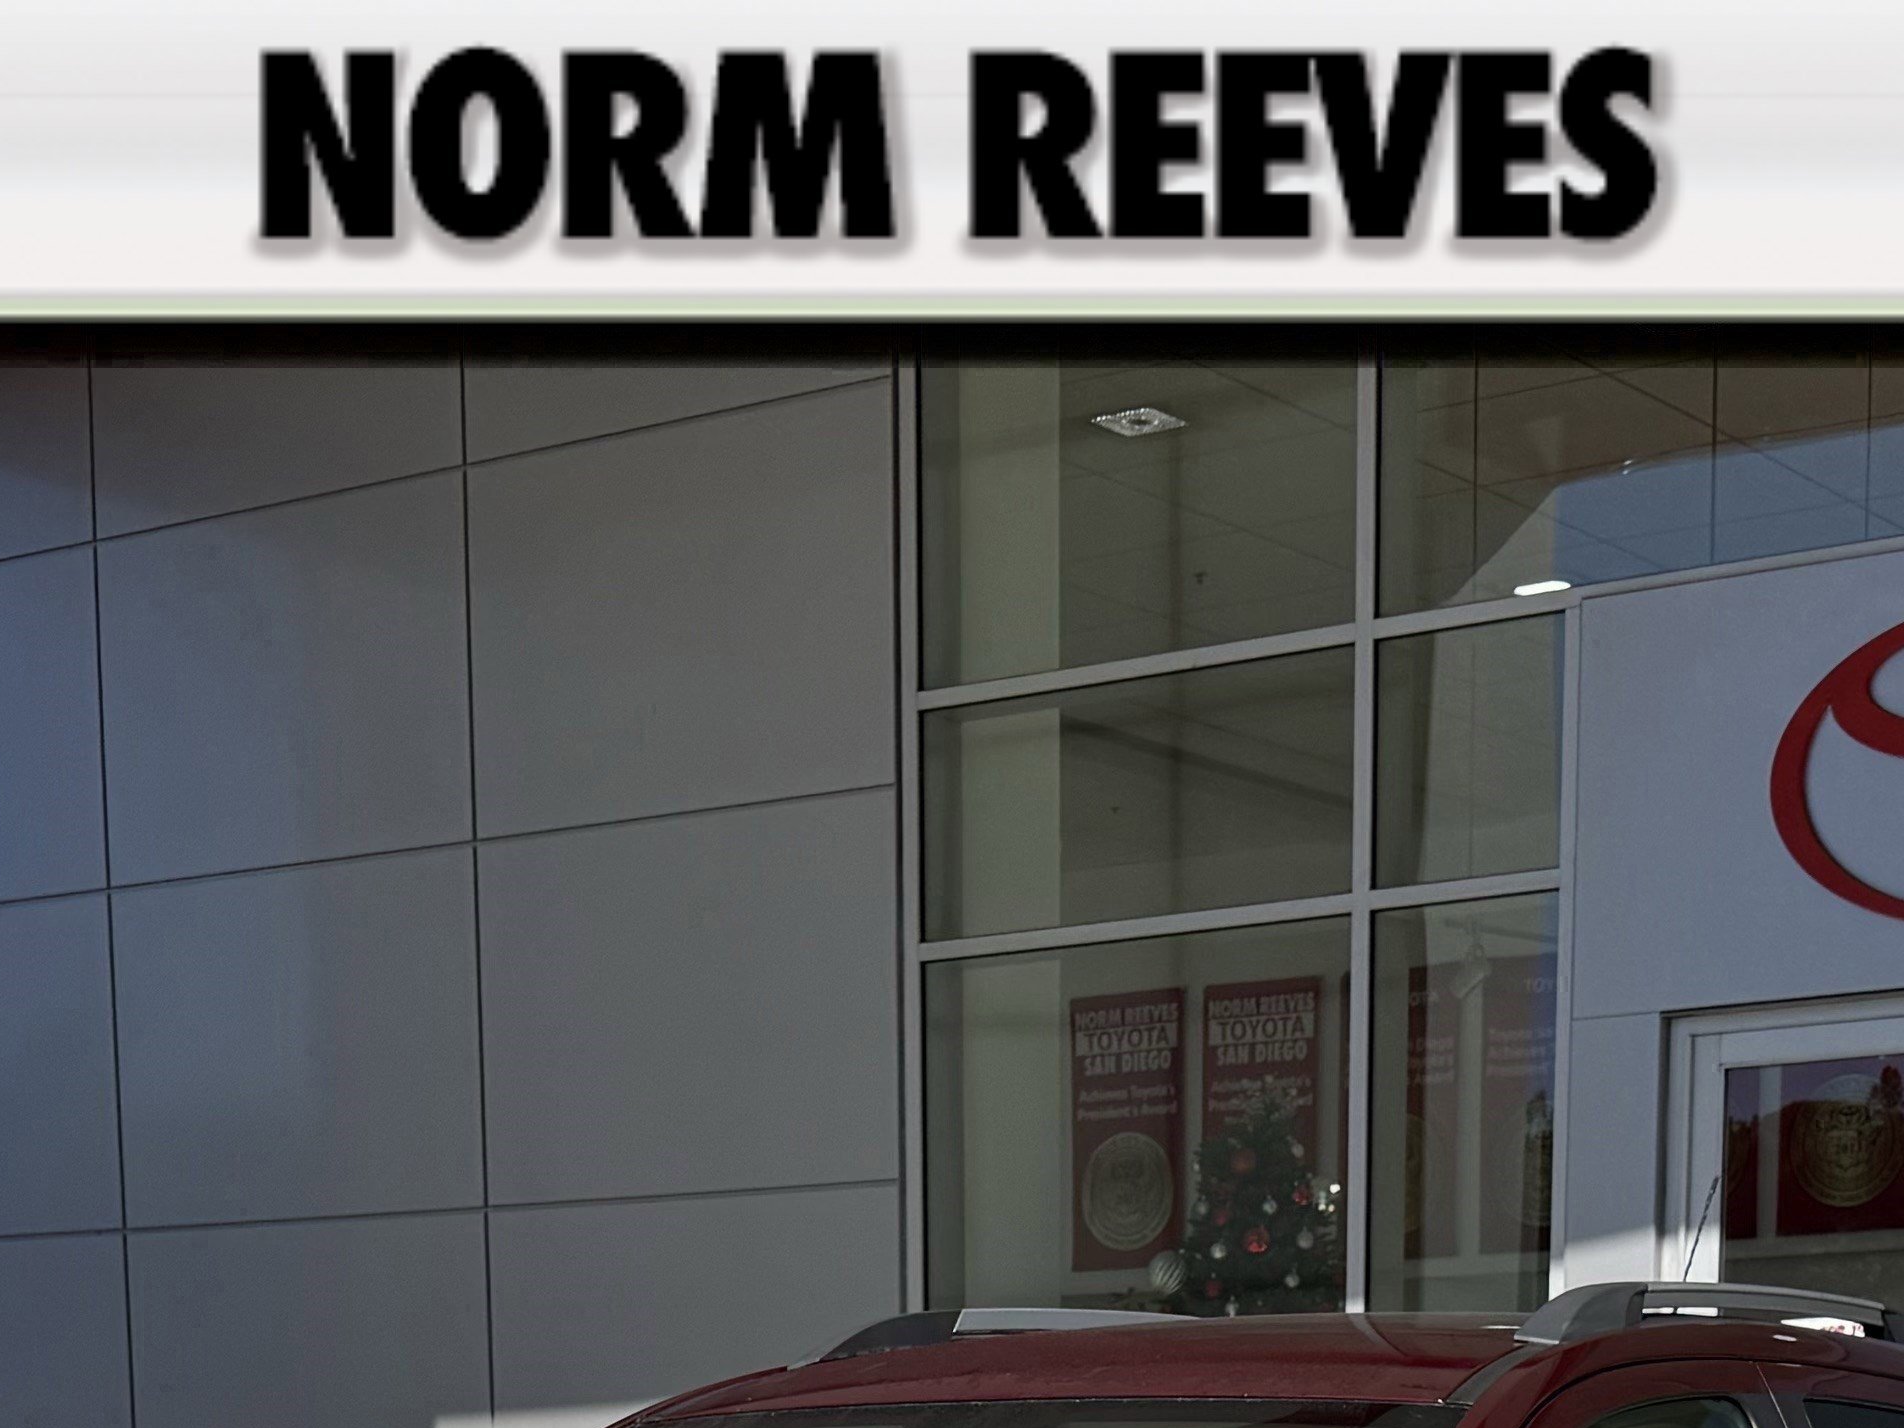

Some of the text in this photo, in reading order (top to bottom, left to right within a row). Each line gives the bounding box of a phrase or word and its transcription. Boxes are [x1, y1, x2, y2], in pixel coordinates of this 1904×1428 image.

[1075, 1003, 1179, 1032] NORM REEVES
[1208, 992, 1315, 1019] NORM REEVES
[1084, 1026, 1170, 1051] TOYOTA
[1219, 1016, 1306, 1041] TOYOTA
[1085, 1050, 1171, 1077] SAN DIEGO
[1217, 1040, 1307, 1067] SAN DIEGO
